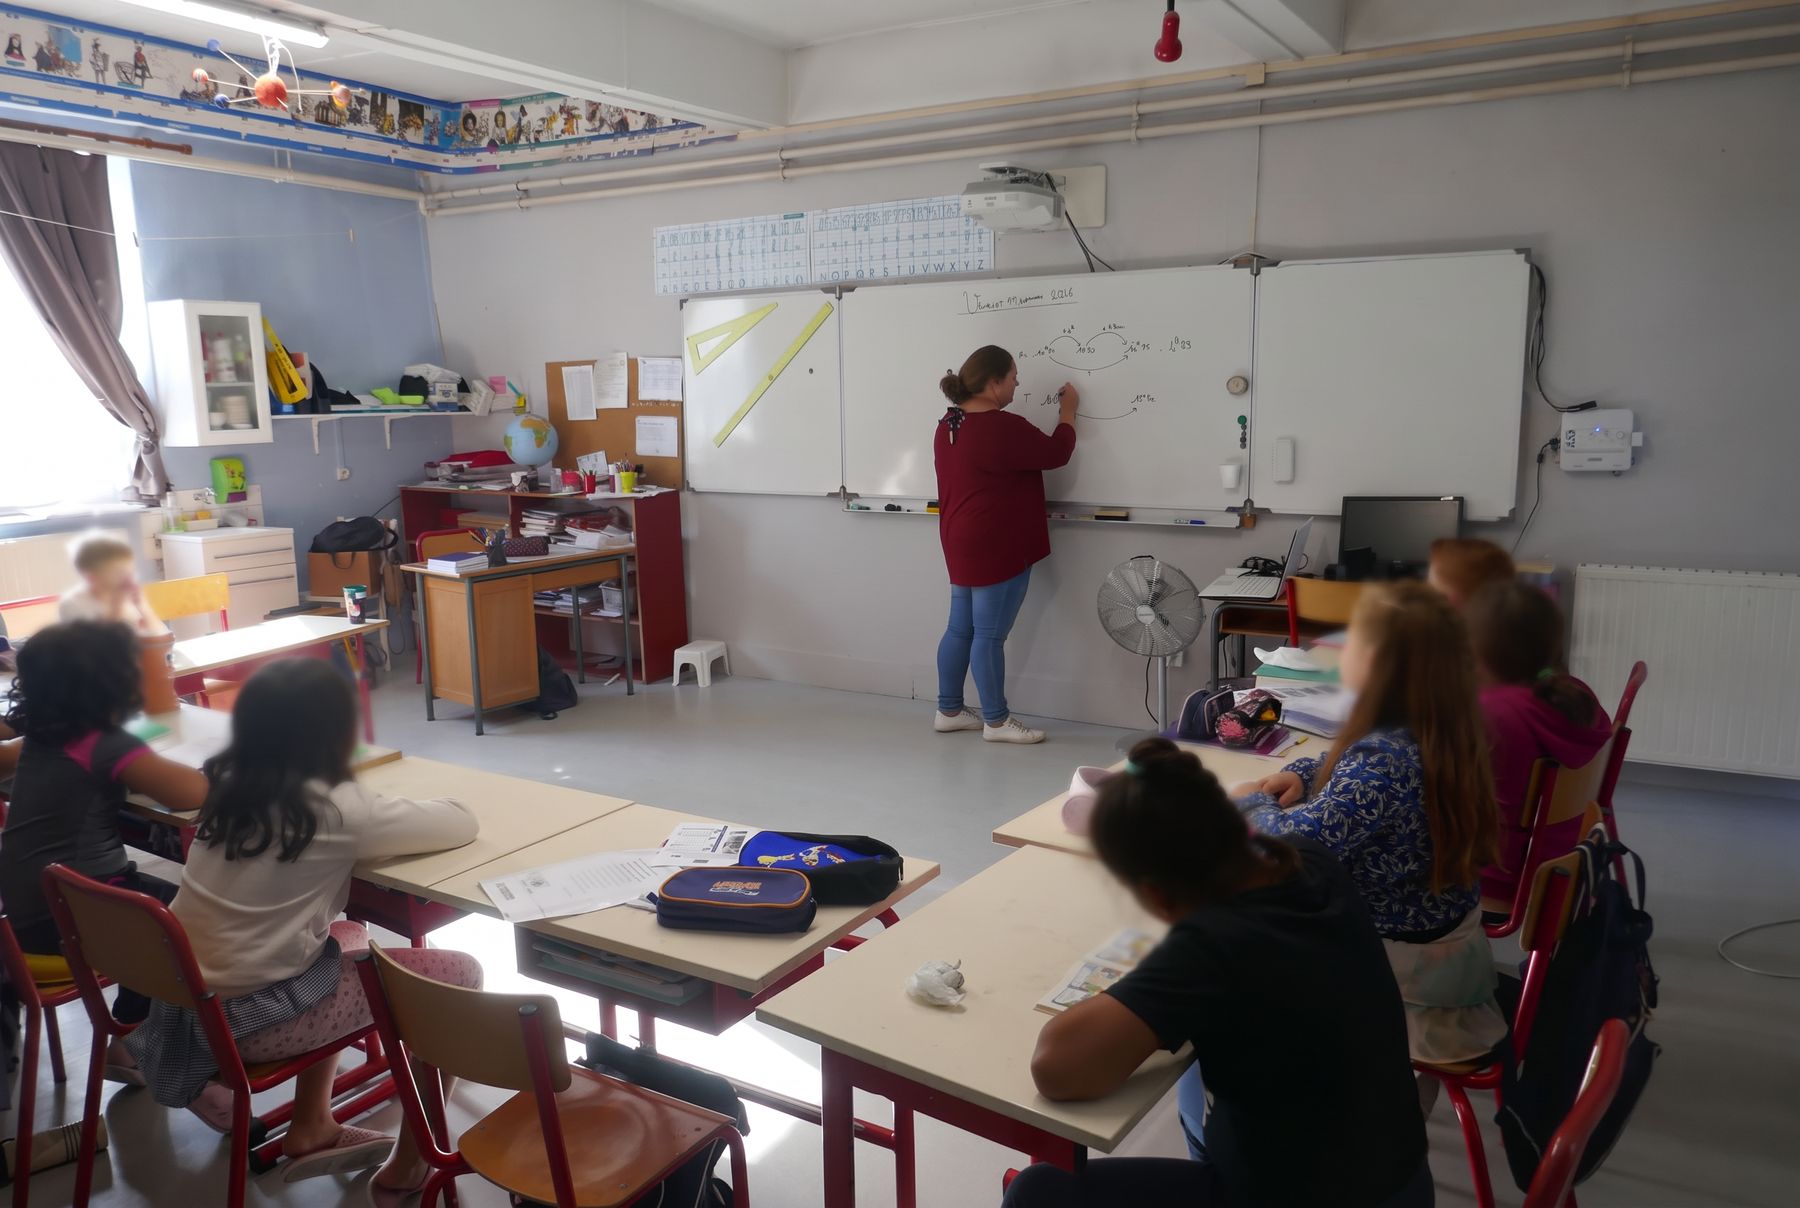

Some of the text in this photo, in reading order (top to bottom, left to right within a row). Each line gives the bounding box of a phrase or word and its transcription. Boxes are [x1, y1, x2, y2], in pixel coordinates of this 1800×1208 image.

[869, 267, 875, 279] R
[908, 264, 916, 275] U
[922, 263, 929, 273] V
[933, 263, 945, 273] W
[949, 261, 956, 272] X
[963, 260, 970, 271] Y
[977, 259, 984, 270] Z
